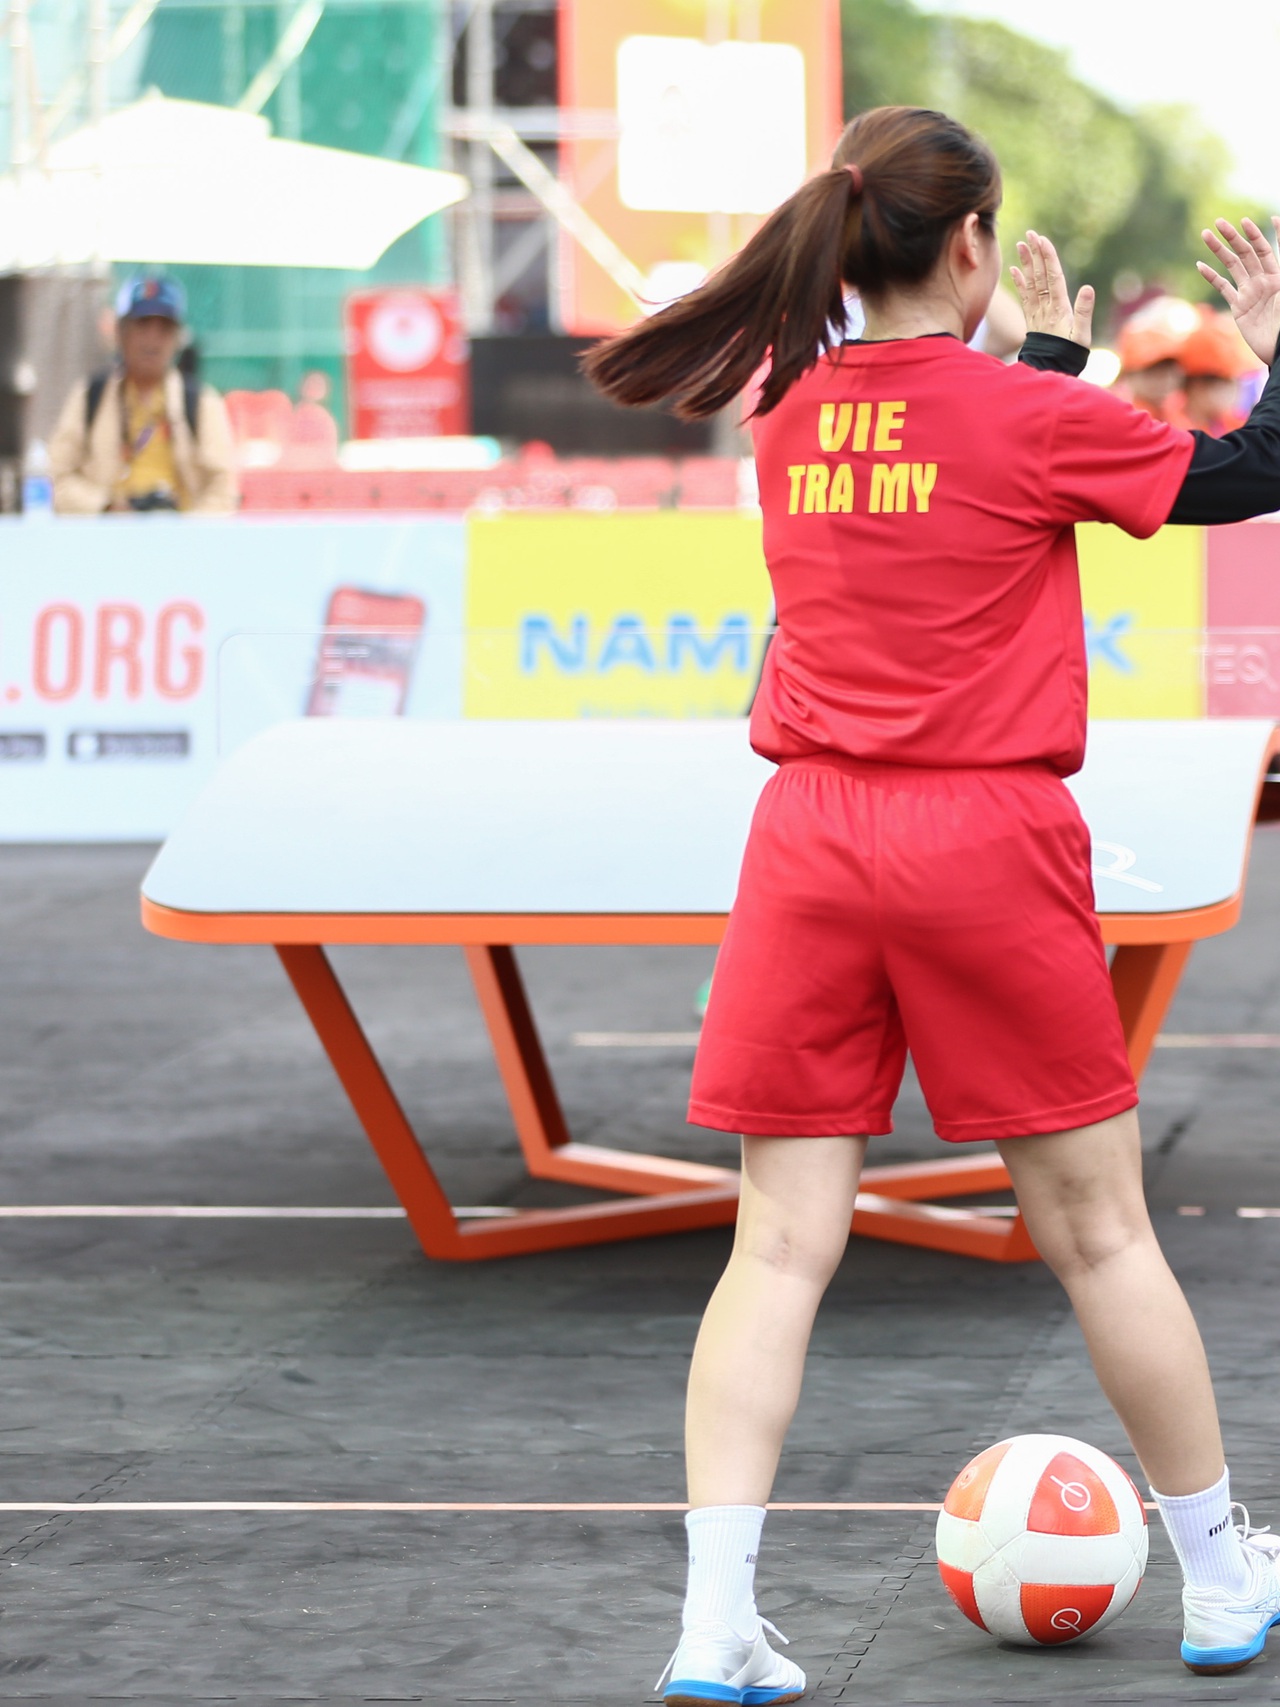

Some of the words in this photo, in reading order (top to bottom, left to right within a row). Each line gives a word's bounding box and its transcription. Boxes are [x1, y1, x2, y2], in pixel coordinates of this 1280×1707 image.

[818, 401, 906, 452] VIE
[787, 463, 854, 515] TRA
[868, 463, 938, 513] MY
[519, 613, 751, 673] NAM
